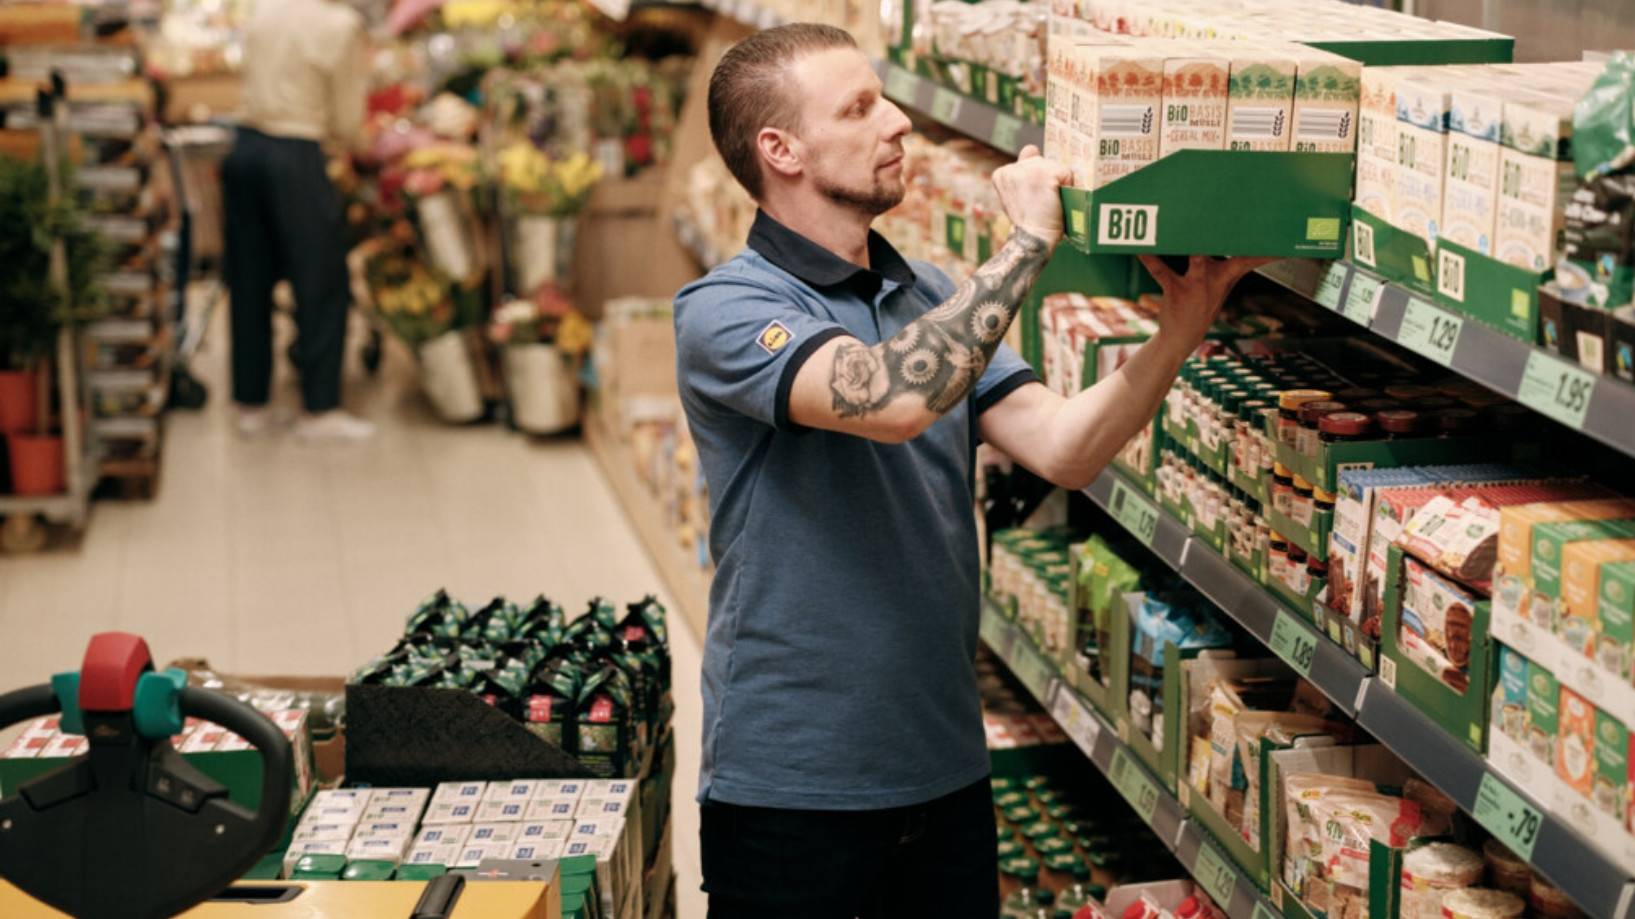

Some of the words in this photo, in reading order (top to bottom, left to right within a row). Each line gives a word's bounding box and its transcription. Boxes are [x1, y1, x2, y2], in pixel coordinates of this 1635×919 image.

[1167, 104, 1188, 122] BiO
[1099, 139, 1120, 156] BiO
[1108, 208, 1149, 240] BiO
[1428, 316, 1458, 352] 1.29
[1555, 372, 1591, 413] 1.95
[1292, 636, 1314, 670] 1.89
